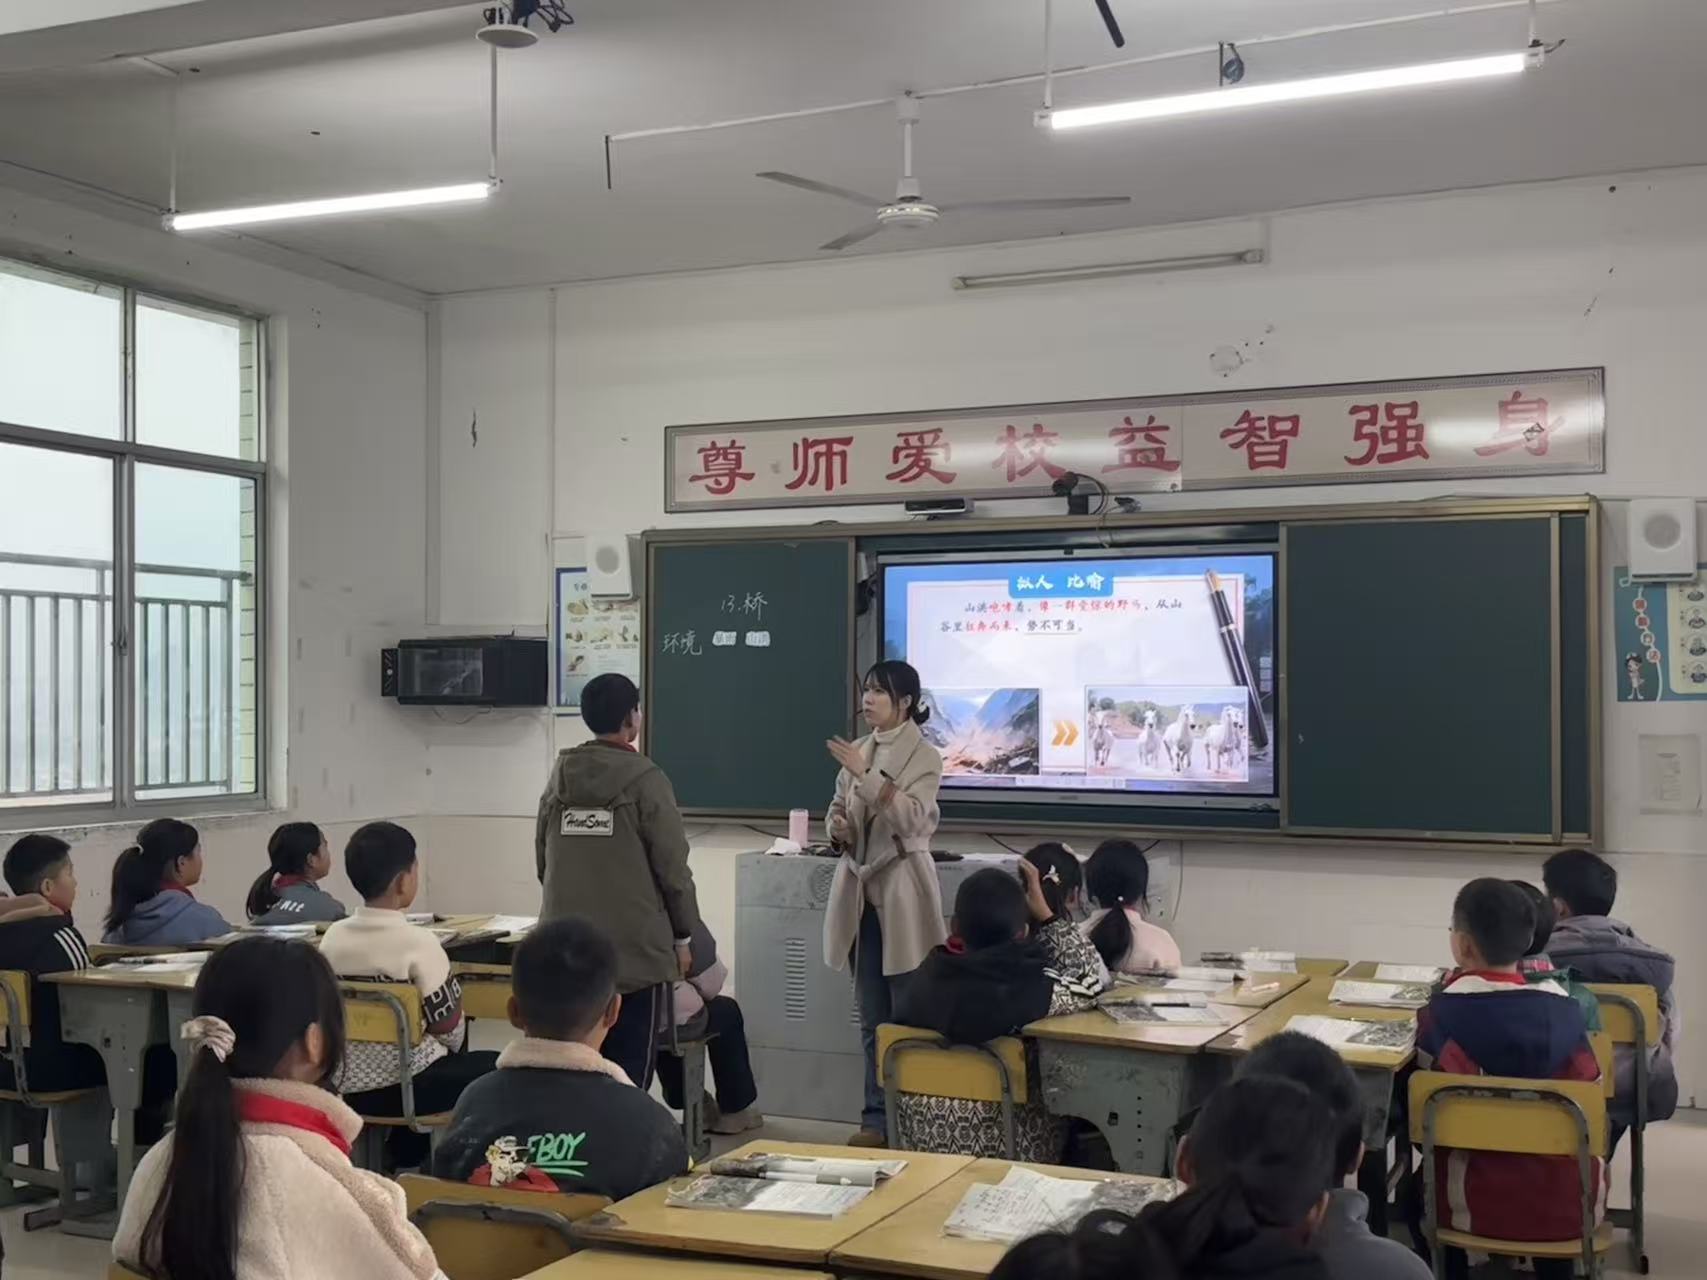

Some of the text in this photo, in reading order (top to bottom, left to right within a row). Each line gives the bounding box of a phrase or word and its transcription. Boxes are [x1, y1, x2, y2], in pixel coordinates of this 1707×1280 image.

[689, 390, 1565, 495] 尊师爱校益智强身
[1016, 571, 1105, 591] 拟人 比喻
[662, 629, 703, 656] 环境
